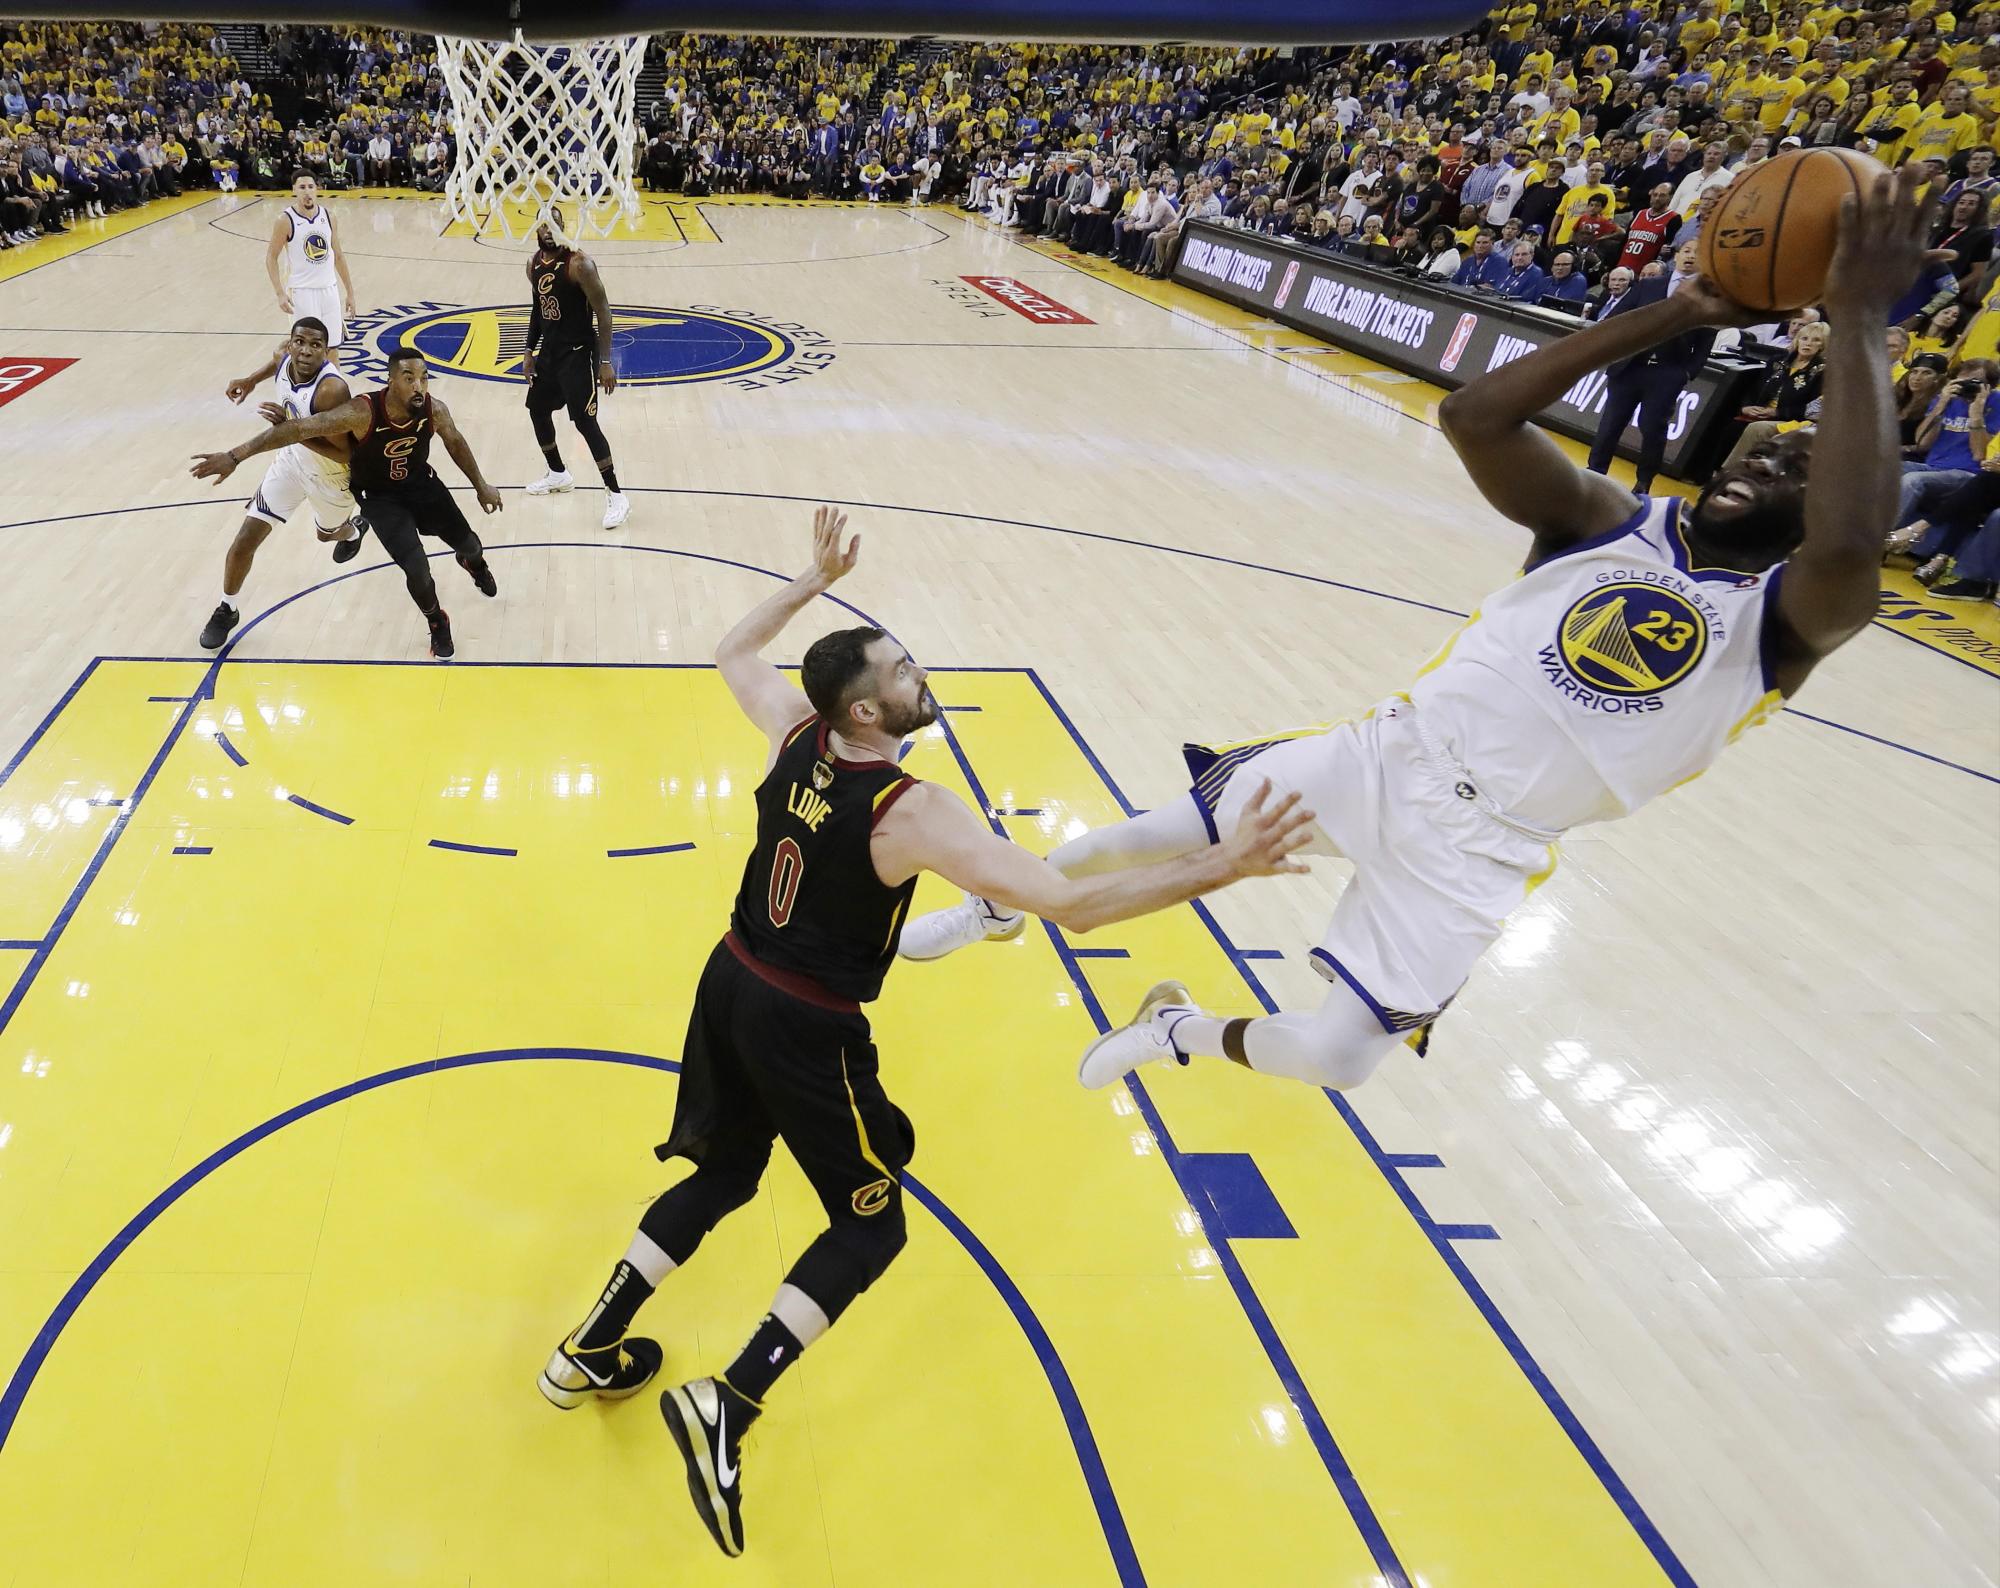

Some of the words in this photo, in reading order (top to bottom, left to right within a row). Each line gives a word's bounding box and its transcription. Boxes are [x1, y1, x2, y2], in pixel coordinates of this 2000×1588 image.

[1625, 240, 1644, 255] 30
[539, 294, 562, 321] 23
[924, 278, 1008, 319] ARENA
[979, 279, 1075, 321] ORACLE
[688, 304, 836, 348] GOLDEN
[727, 351, 836, 391] STATE
[389, 457, 409, 481] 5
[1596, 569, 1690, 593] GOLDEN
[1691, 592, 1726, 642] STATE
[1631, 610, 1696, 652] 23
[1537, 643, 1665, 715] WARRIORS
[787, 781, 833, 833] LOVE
[768, 836, 804, 929] 0
